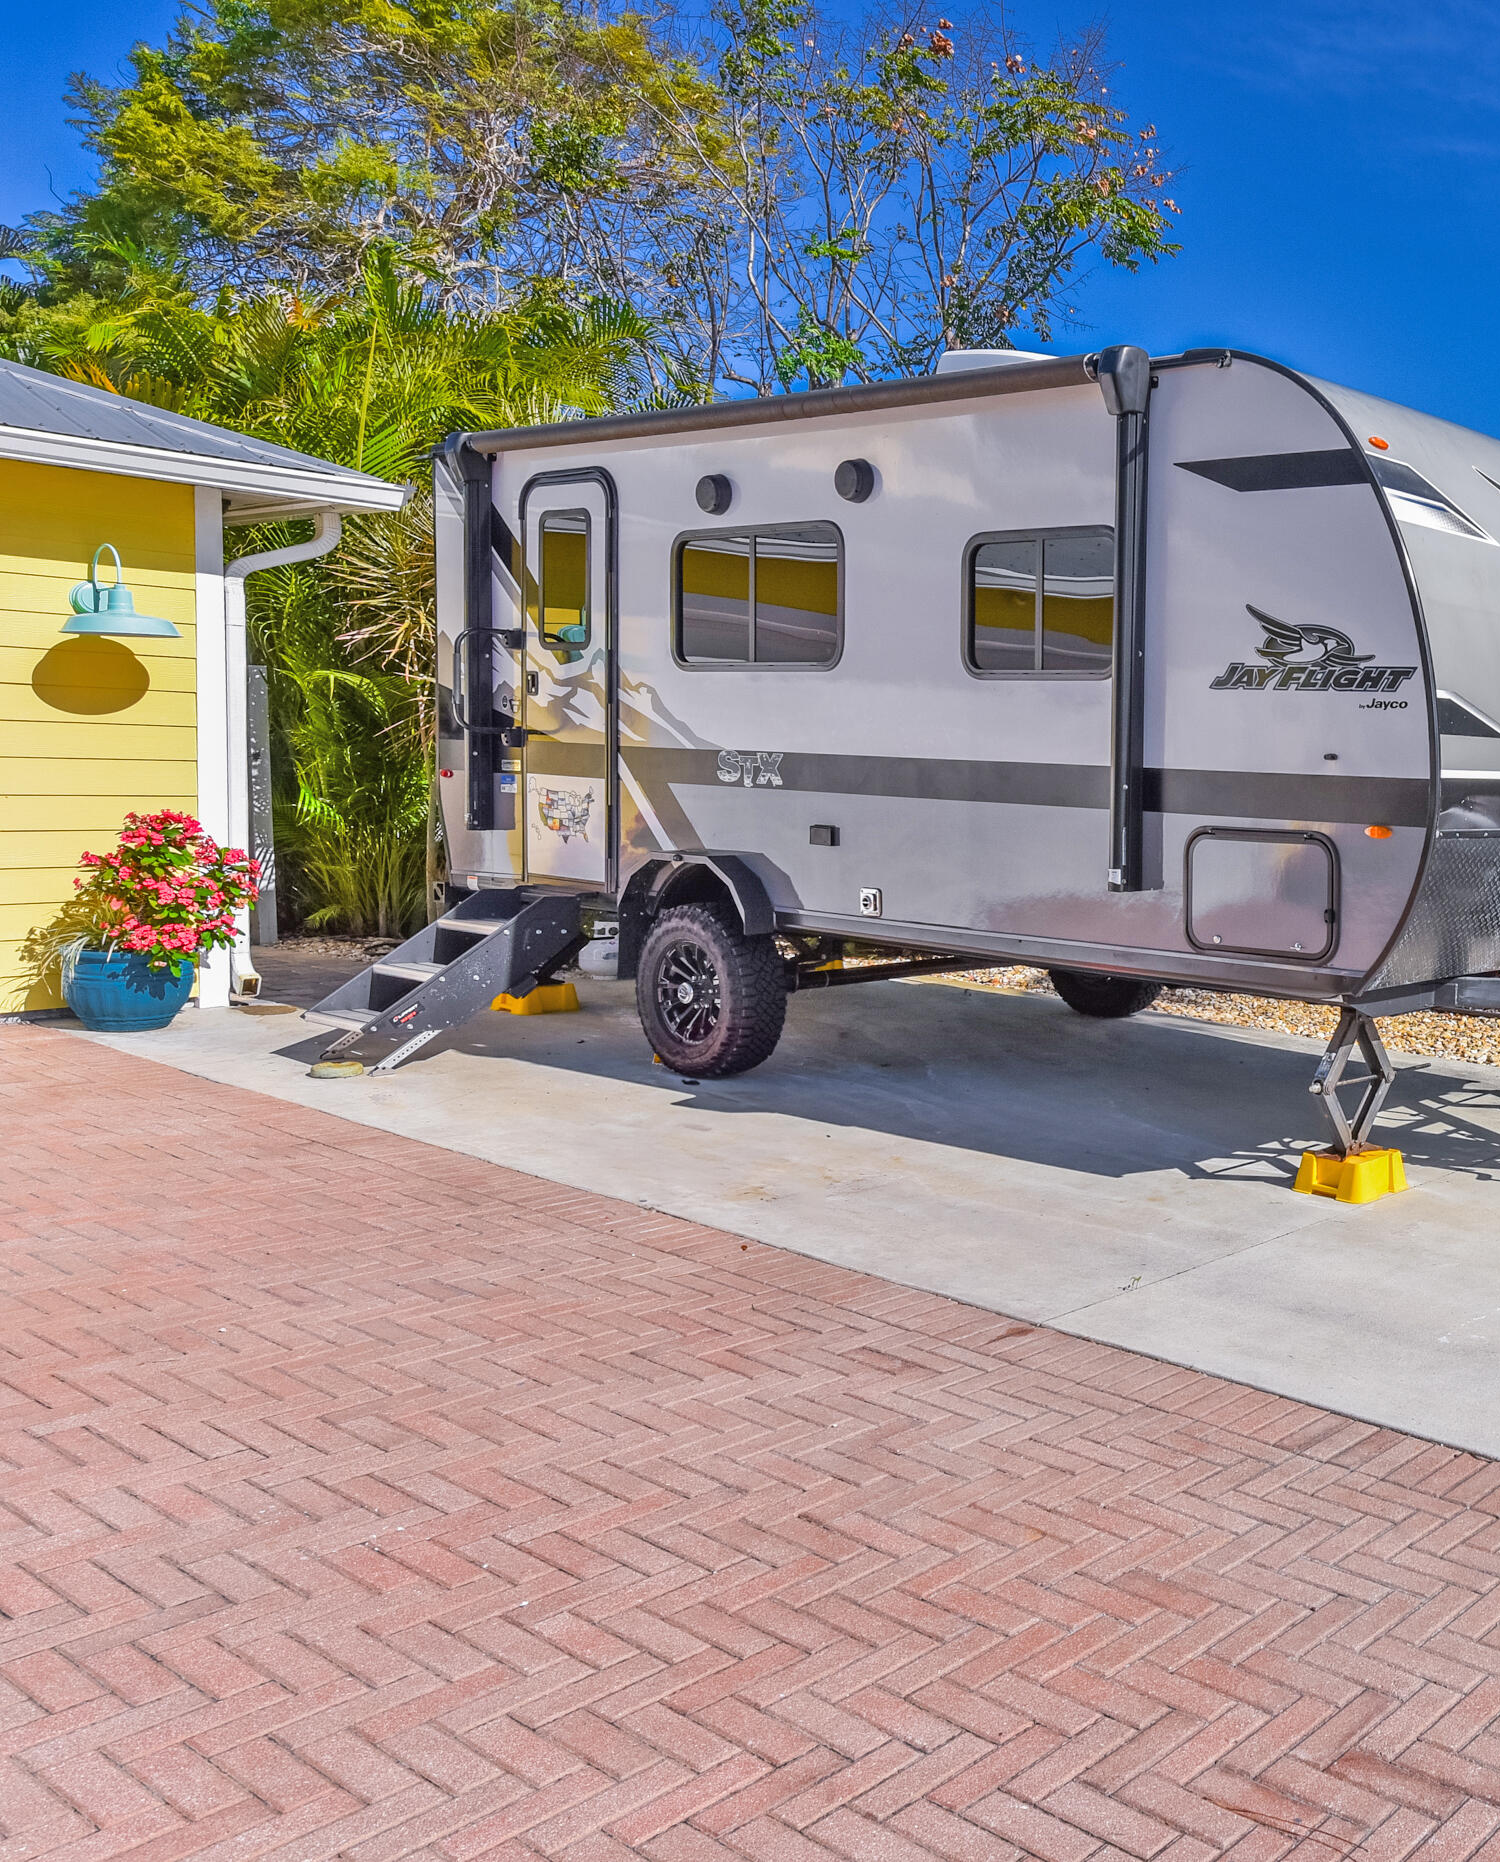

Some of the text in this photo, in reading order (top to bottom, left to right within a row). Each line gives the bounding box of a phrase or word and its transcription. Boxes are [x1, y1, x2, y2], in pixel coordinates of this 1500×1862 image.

[1209, 663, 1418, 692] JAY FLIGHT
[1366, 698, 1409, 711] Jayco
[716, 750, 784, 788] STX
